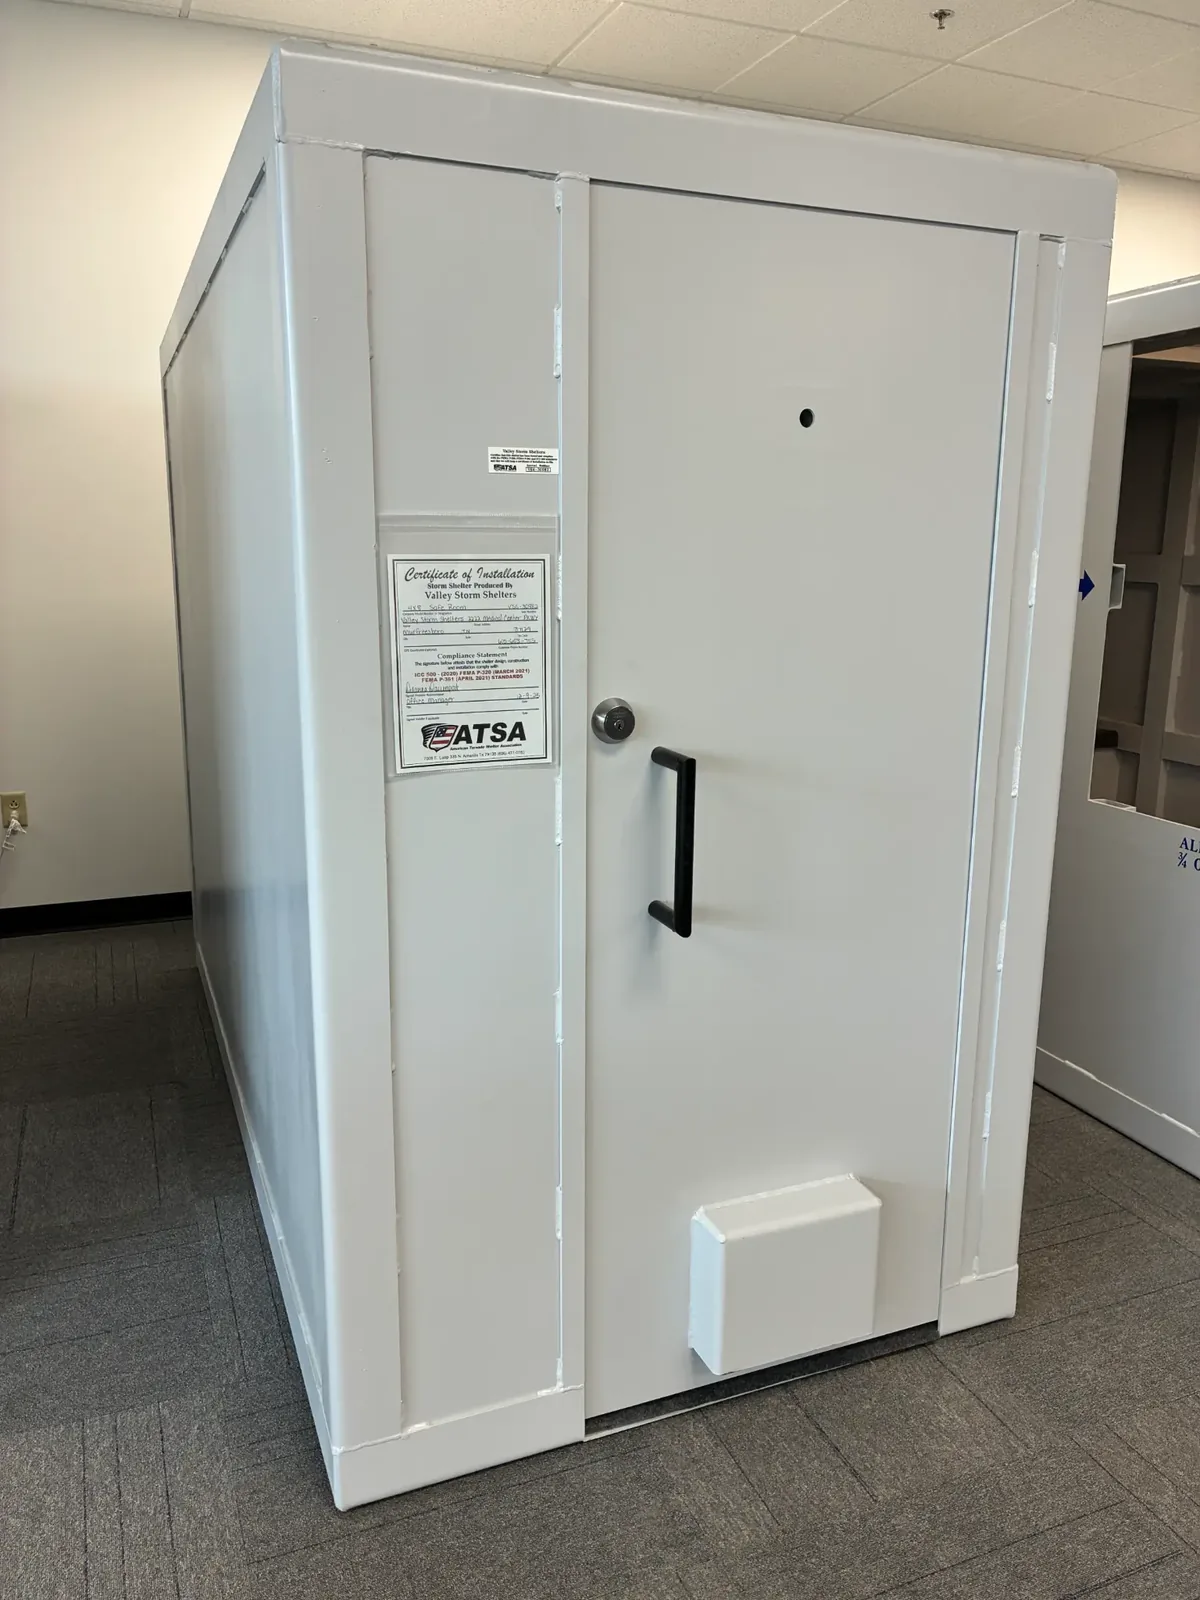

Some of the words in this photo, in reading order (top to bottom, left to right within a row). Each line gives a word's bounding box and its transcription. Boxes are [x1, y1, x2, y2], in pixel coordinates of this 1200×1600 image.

[405, 567, 458, 582] Certificate
[462, 568, 472, 582] of
[477, 567, 535, 579] Installation
[425, 591, 452, 601] Valley
[455, 591, 480, 599] Storm
[483, 591, 517, 599] Shelters
[452, 721, 526, 745] ATSA
[1179, 837, 1200, 853] AL
